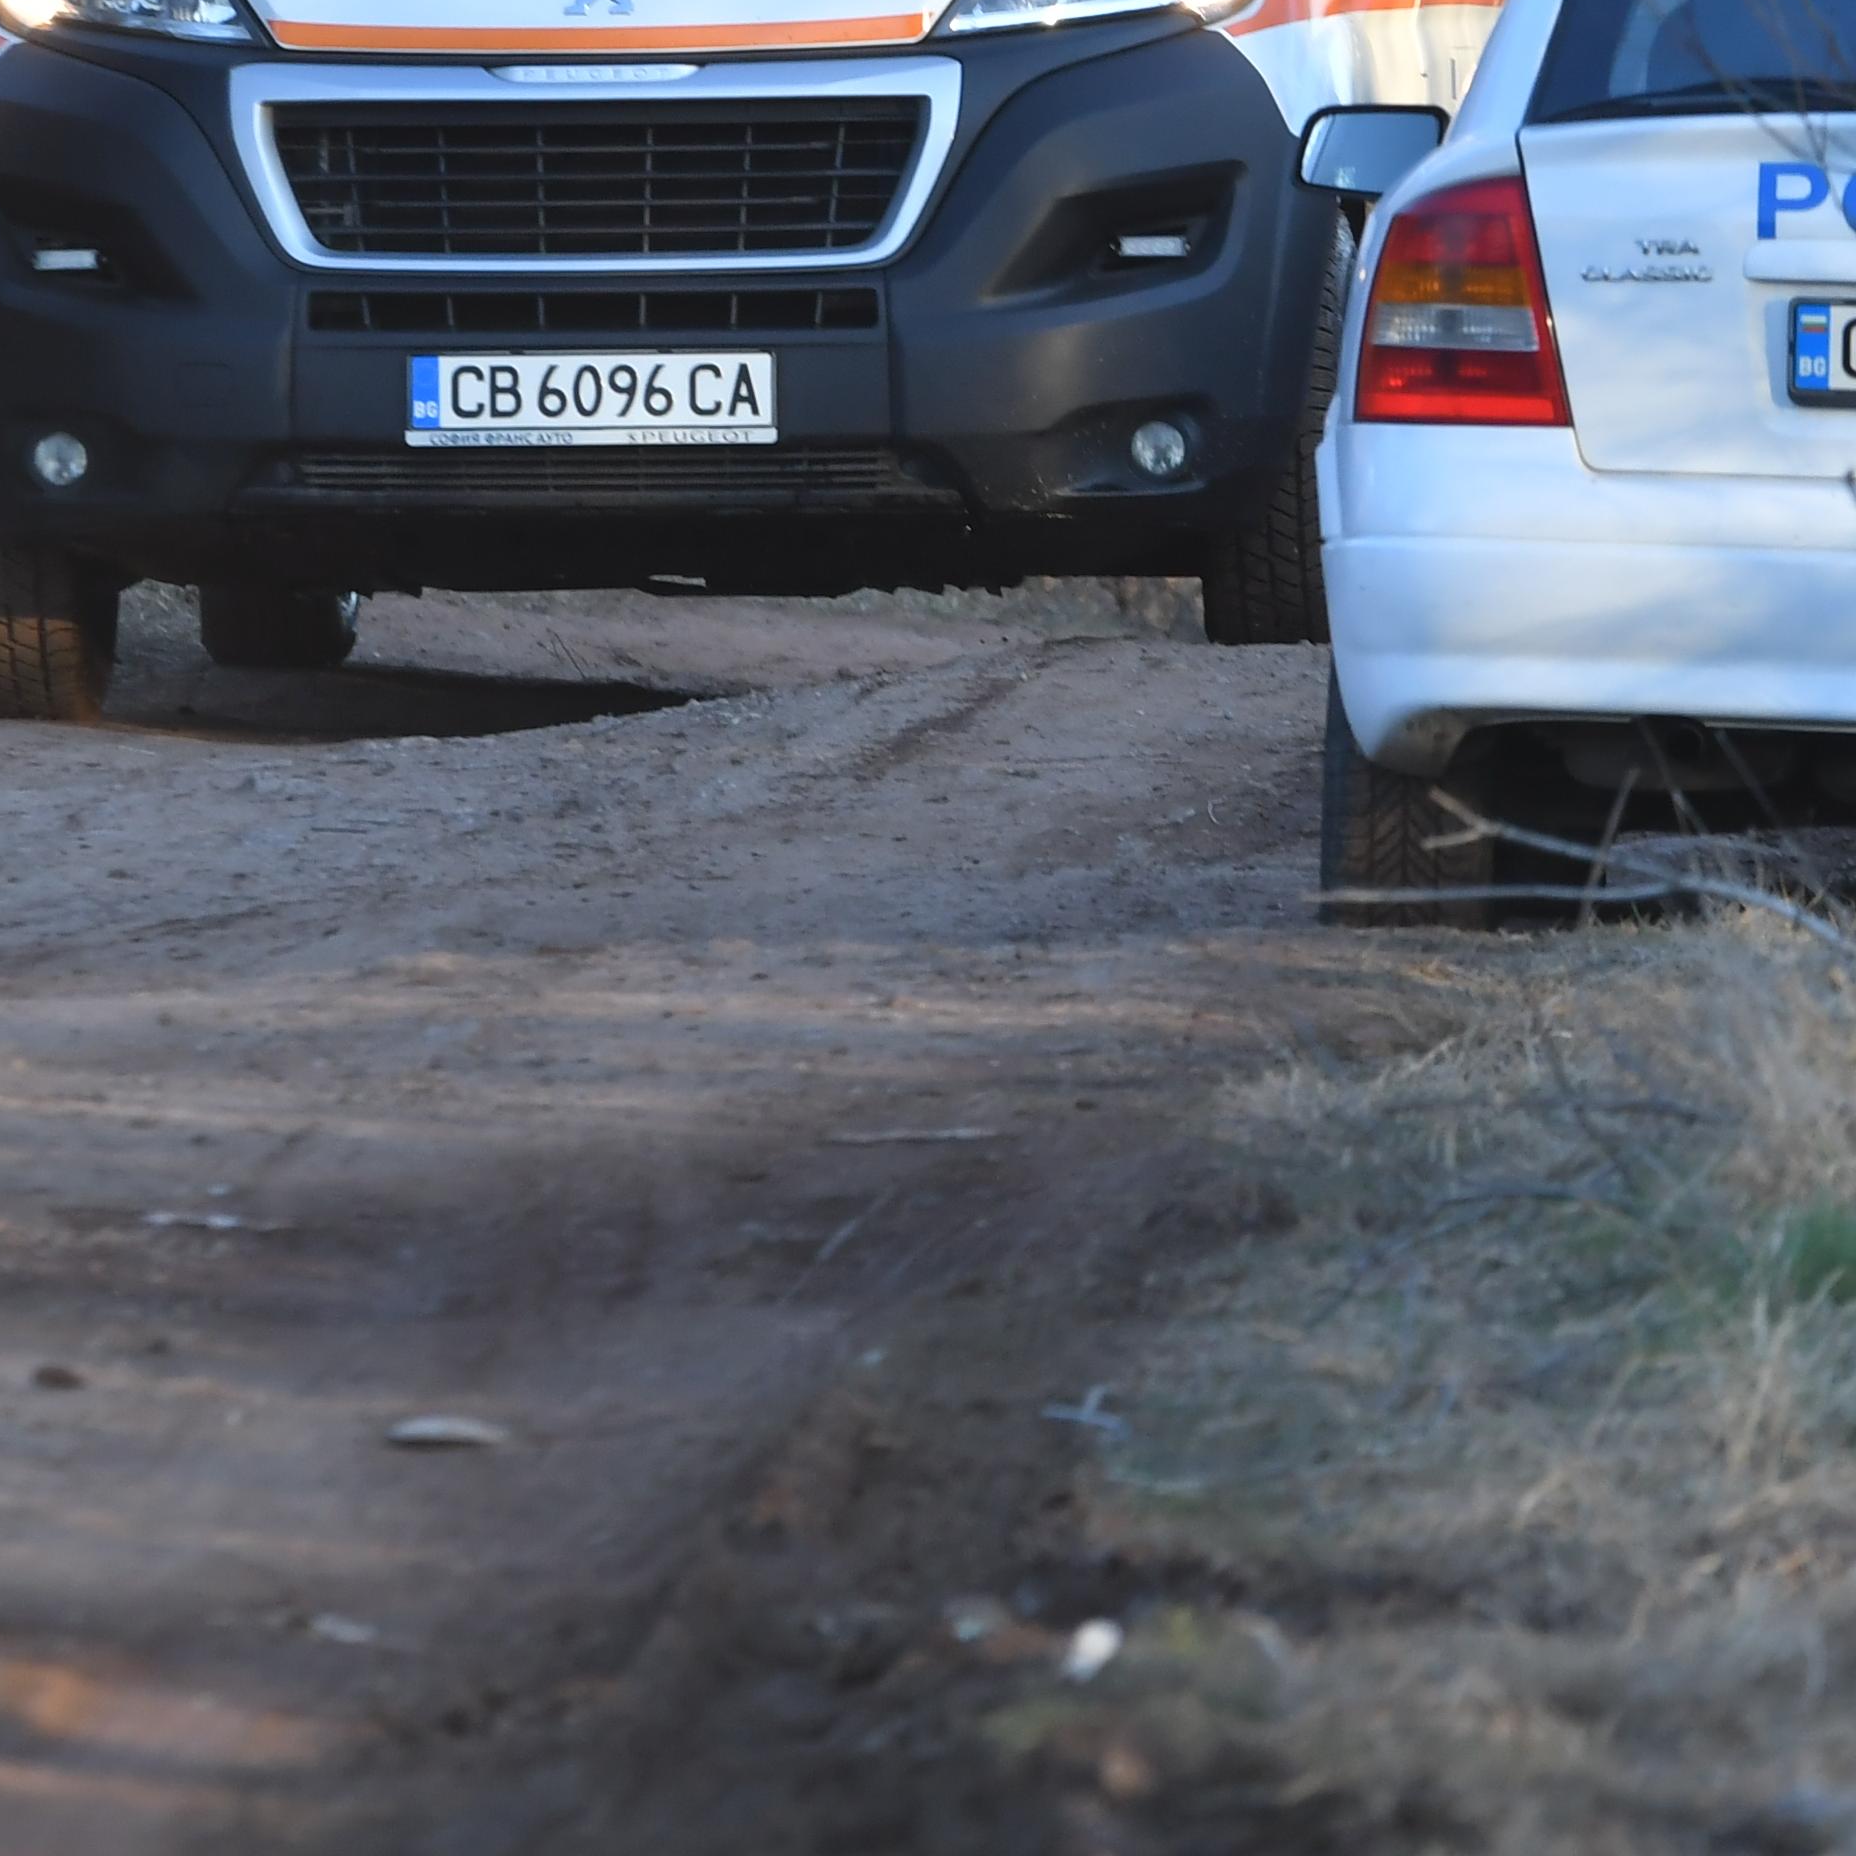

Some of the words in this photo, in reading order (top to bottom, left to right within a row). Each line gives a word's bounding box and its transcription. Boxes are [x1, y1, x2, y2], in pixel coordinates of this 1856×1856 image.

[1799, 356, 1826, 377] BG
[451, 365, 522, 419] CB
[538, 363, 674, 418] 6096
[689, 363, 761, 417] CA
[412, 400, 439, 419] BG
[643, 430, 754, 444] PEUGEOT
